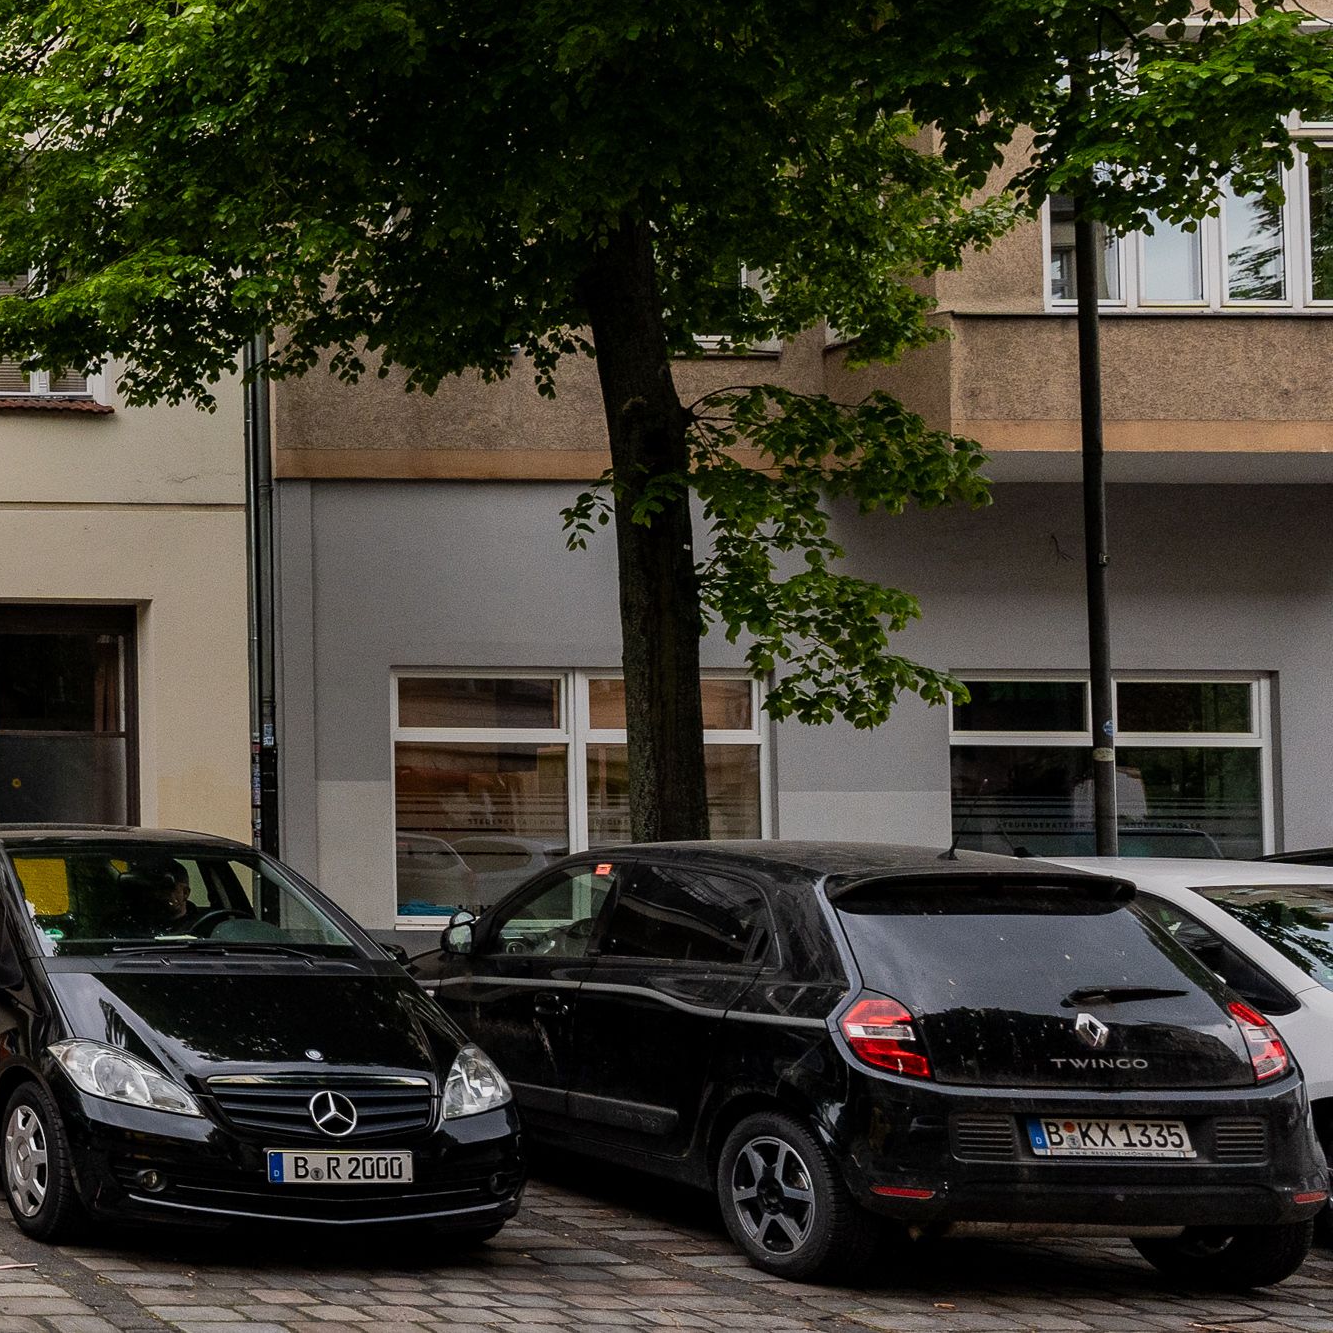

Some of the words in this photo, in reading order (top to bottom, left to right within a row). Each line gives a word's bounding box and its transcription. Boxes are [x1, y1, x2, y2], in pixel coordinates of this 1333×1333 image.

[1050, 1058, 1149, 1070] TWINGO
[1044, 1121, 1065, 1147] B
[1077, 1122, 1116, 1148] KX
[1119, 1123, 1185, 1149] 1335
[294, 1156, 310, 1179] B
[326, 1156, 342, 1180] R
[347, 1156, 403, 1180] 2000
